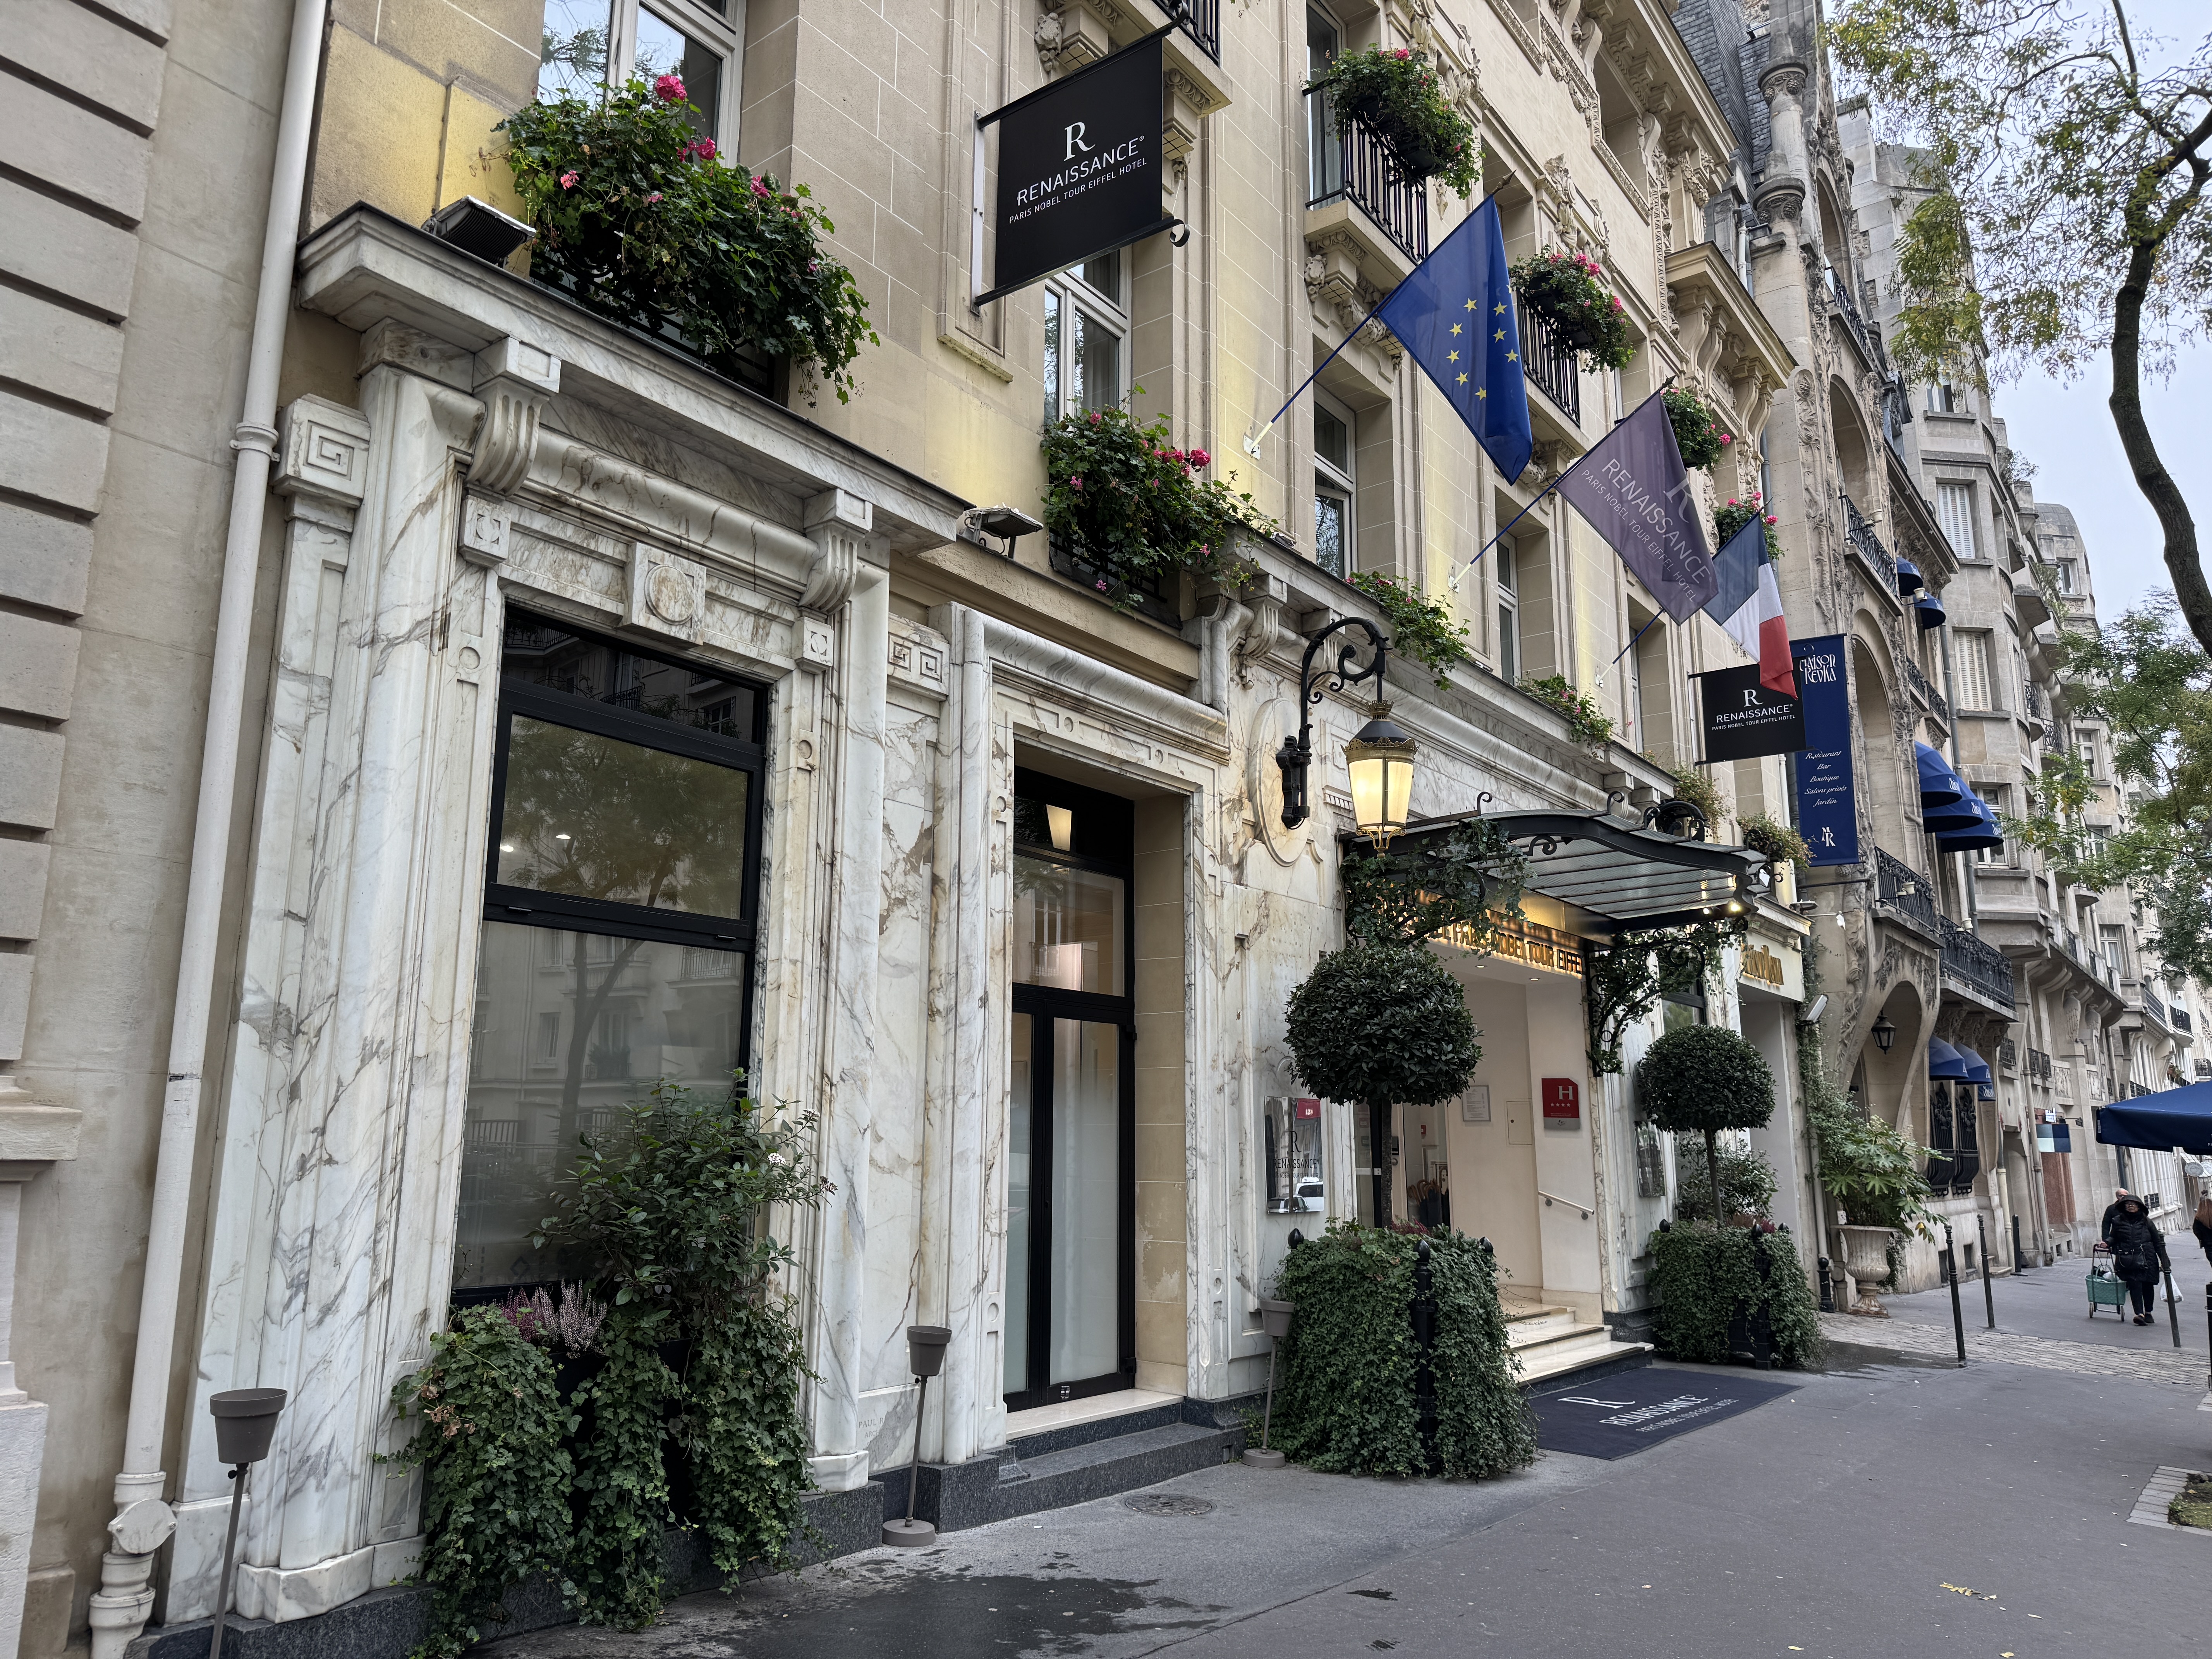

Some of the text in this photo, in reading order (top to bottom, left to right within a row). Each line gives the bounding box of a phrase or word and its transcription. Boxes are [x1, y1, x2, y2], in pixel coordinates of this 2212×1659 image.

[1064, 122, 1096, 161] R
[1009, 158, 1147, 224] PARIS NOBEL TOUR EIFFEL HOTEL
[1602, 458, 1710, 584] RENAISSANCE
[1582, 469, 1697, 602] PARIS NOBEL TOUR EIFFEL HOTEL
[1743, 689, 1764, 707] R
[1826, 785, 1847, 794] privés
[1812, 798, 1838, 807] Jardin
[1527, 940, 1554, 968] TOUR
[1558, 1085, 1574, 1100] H
[1558, 1396, 1636, 1409] R
